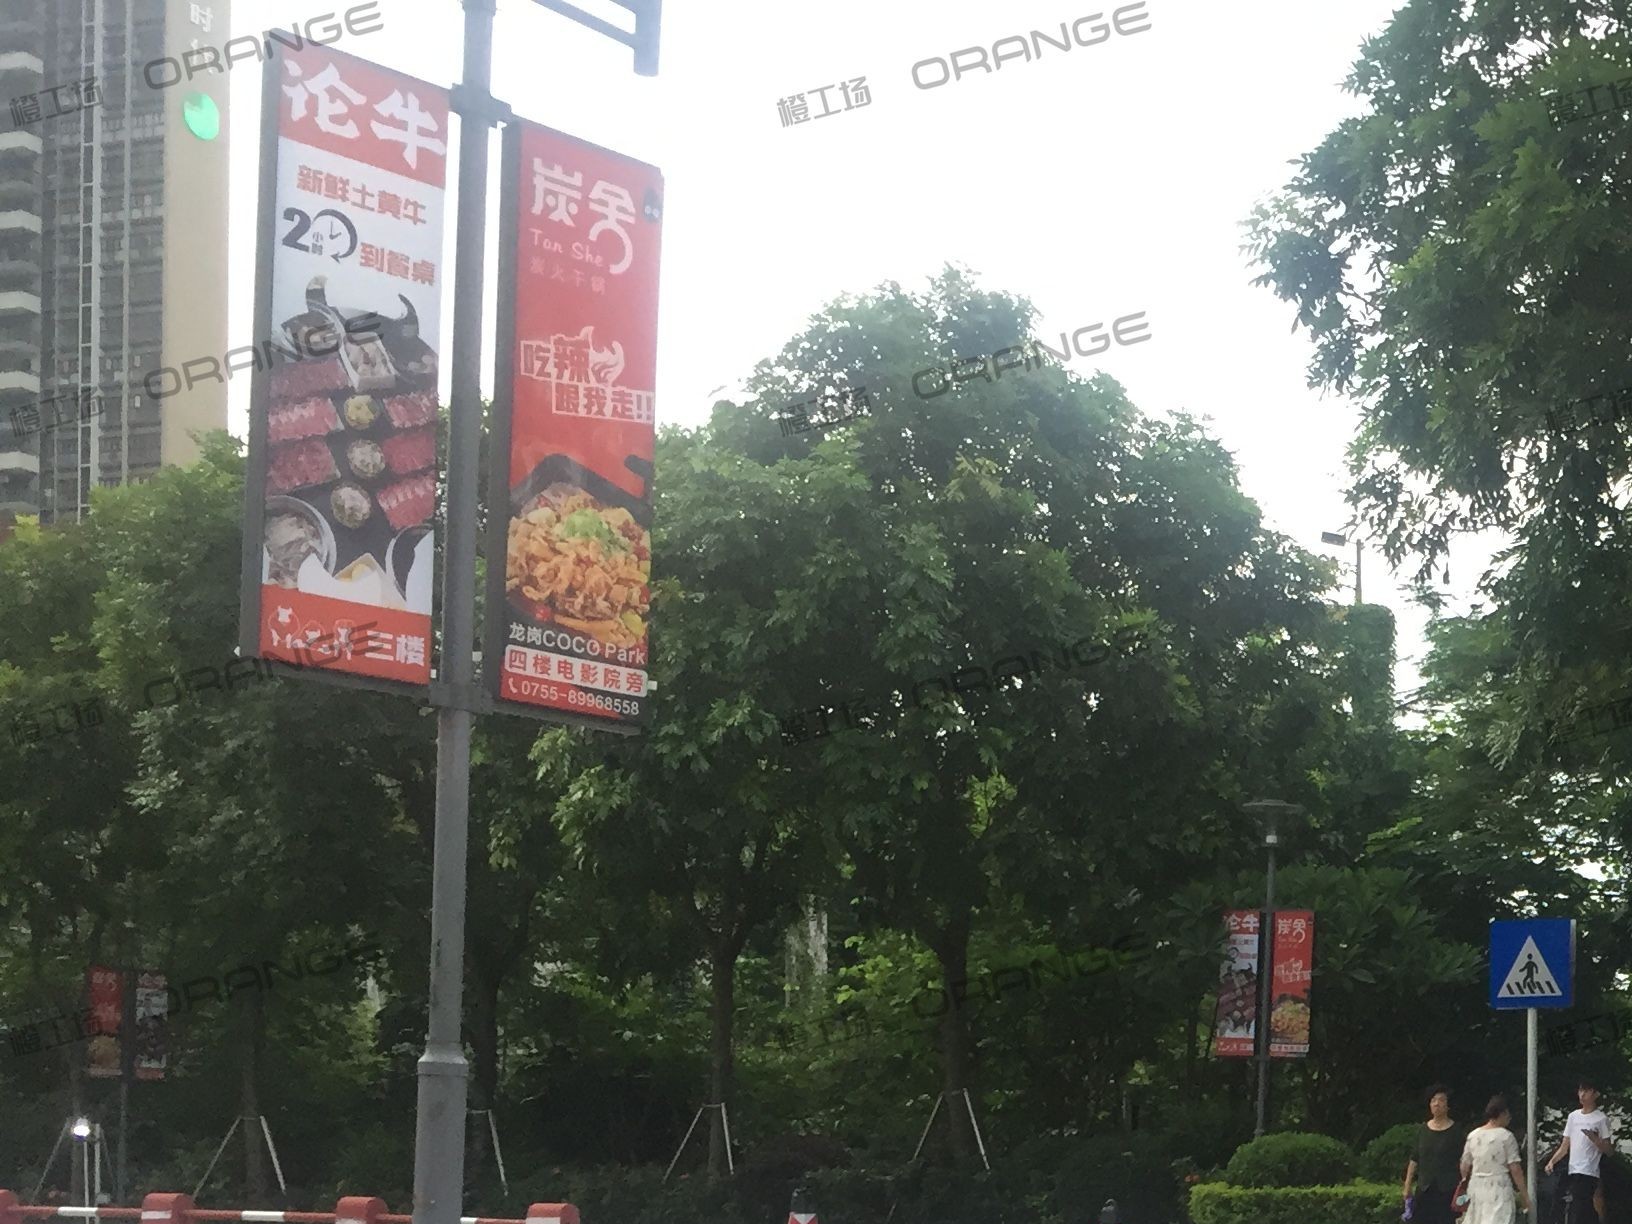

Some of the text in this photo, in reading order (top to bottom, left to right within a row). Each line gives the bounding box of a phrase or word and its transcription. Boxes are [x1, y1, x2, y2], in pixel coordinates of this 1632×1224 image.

[283, 60, 447, 169] 论牛
[297, 165, 426, 225] 新鲜土黄牛
[360, 242, 435, 286] 到餐桌
[529, 228, 604, 267] Tan She
[365, 630, 425, 666] 三楼
[605, 643, 645, 665] Park
[509, 650, 643, 694] 四楼电影院旁
[521, 680, 640, 716] 0755-89968558
